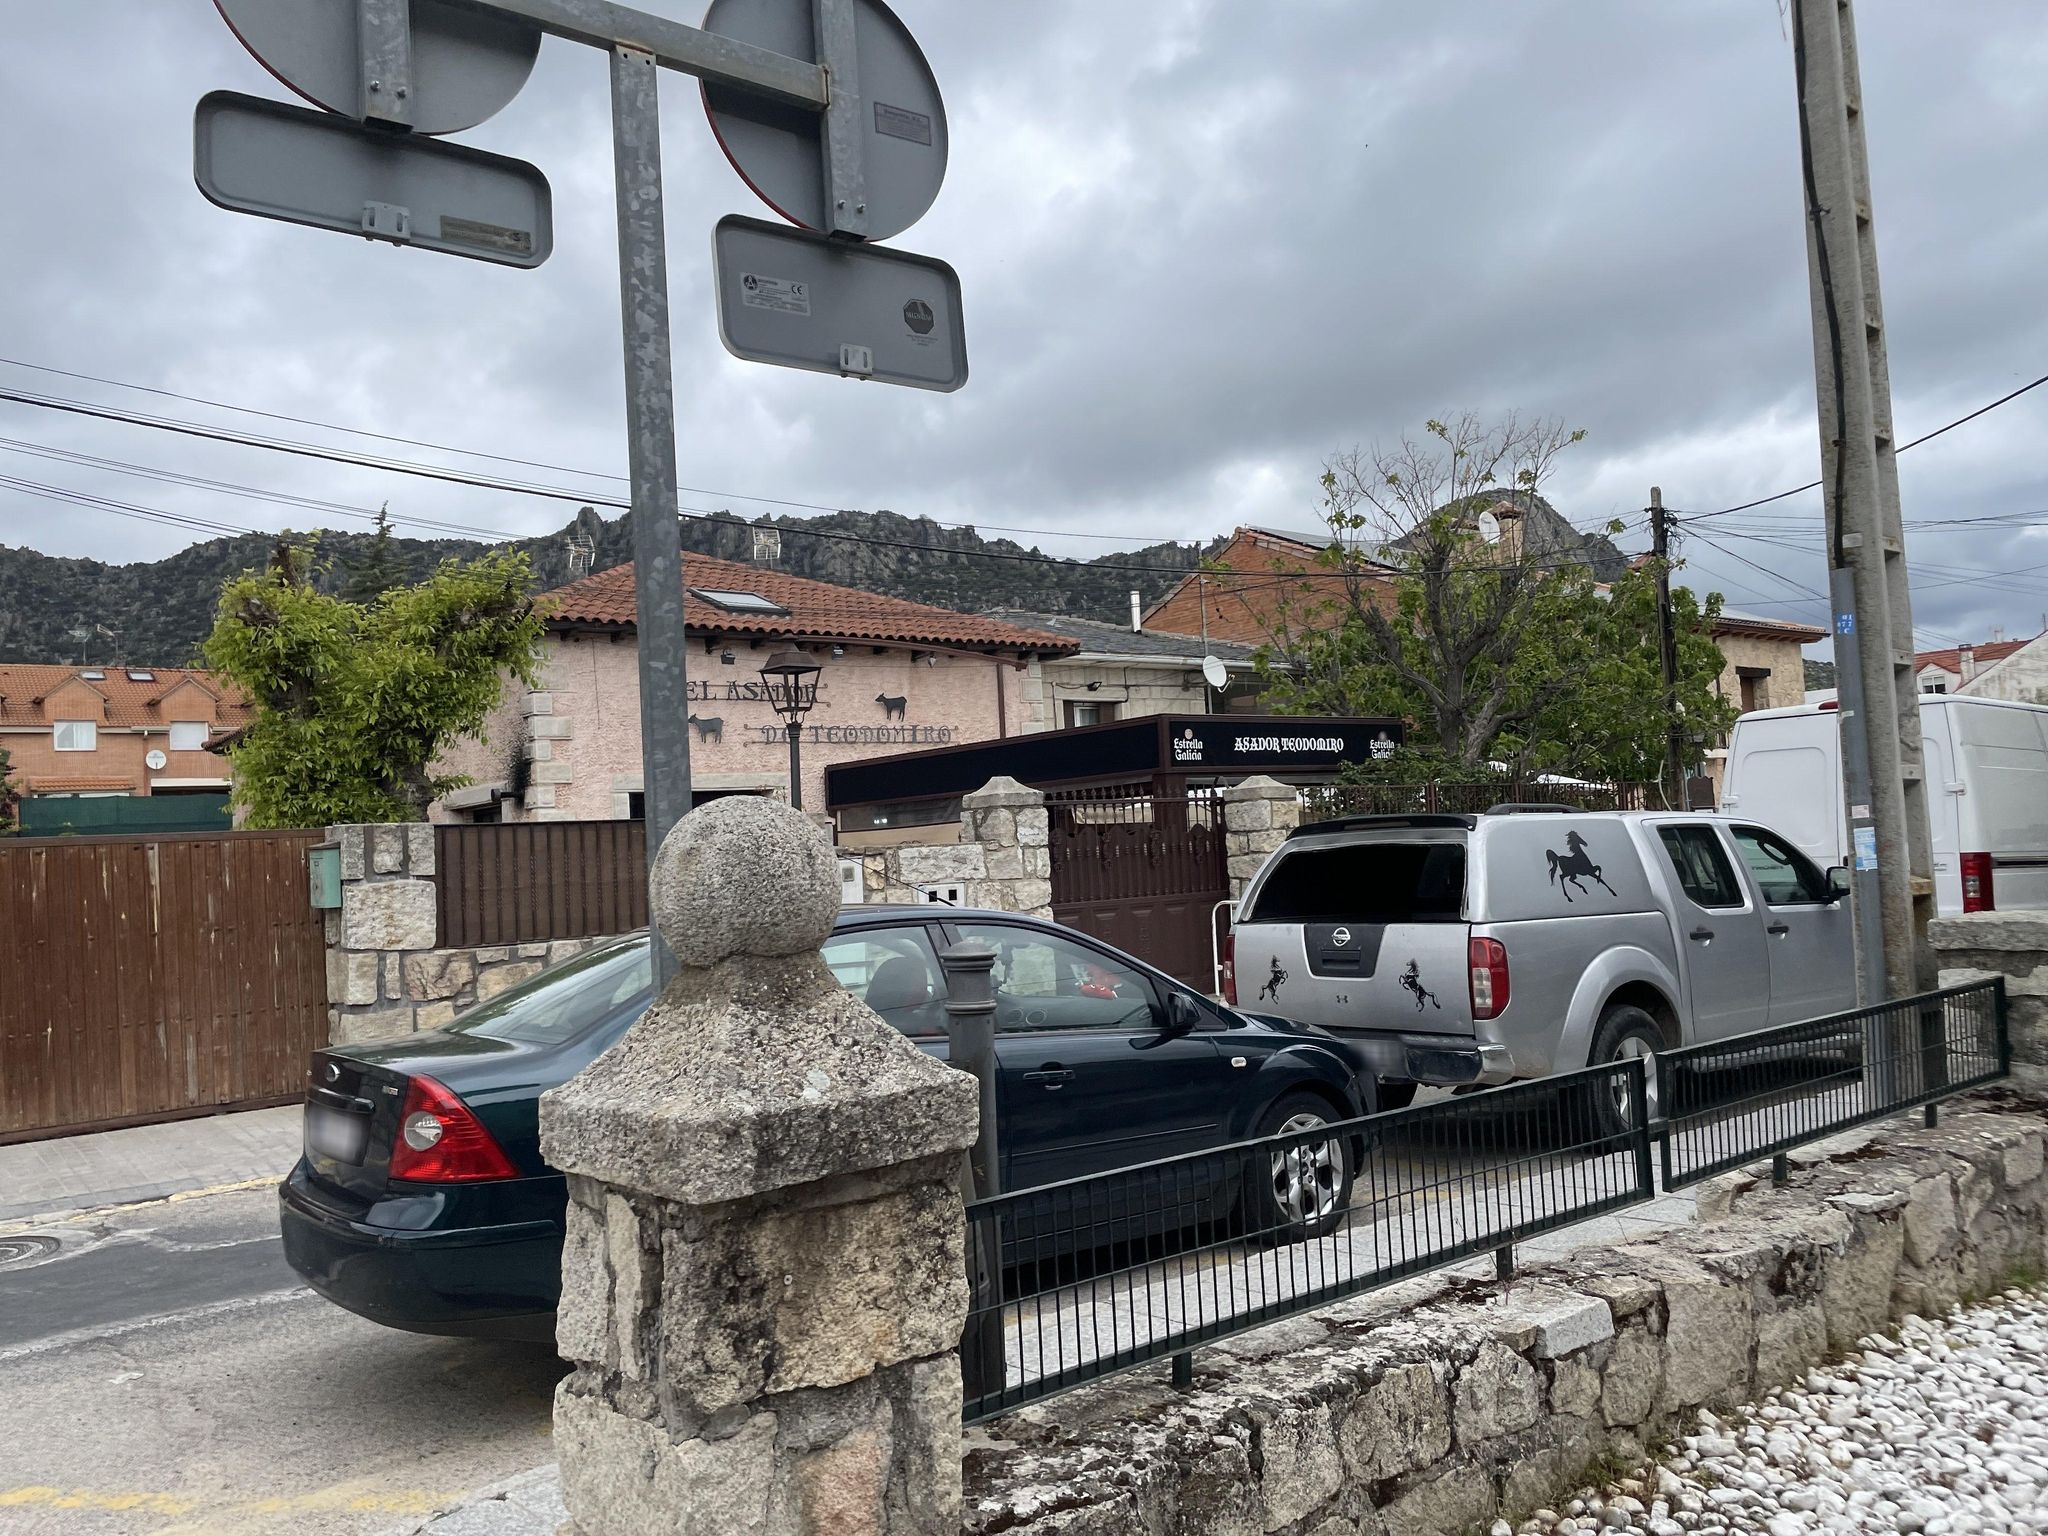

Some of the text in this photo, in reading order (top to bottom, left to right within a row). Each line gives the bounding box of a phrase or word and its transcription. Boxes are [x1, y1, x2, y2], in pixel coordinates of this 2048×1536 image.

[686, 680, 717, 702] EL
[809, 724, 951, 745] TEODOMIRO
[1173, 737, 1203, 750] Estrella
[1234, 736, 1344, 754] ASADOR TEODOMIRO
[1174, 749, 1202, 761] Galicia
